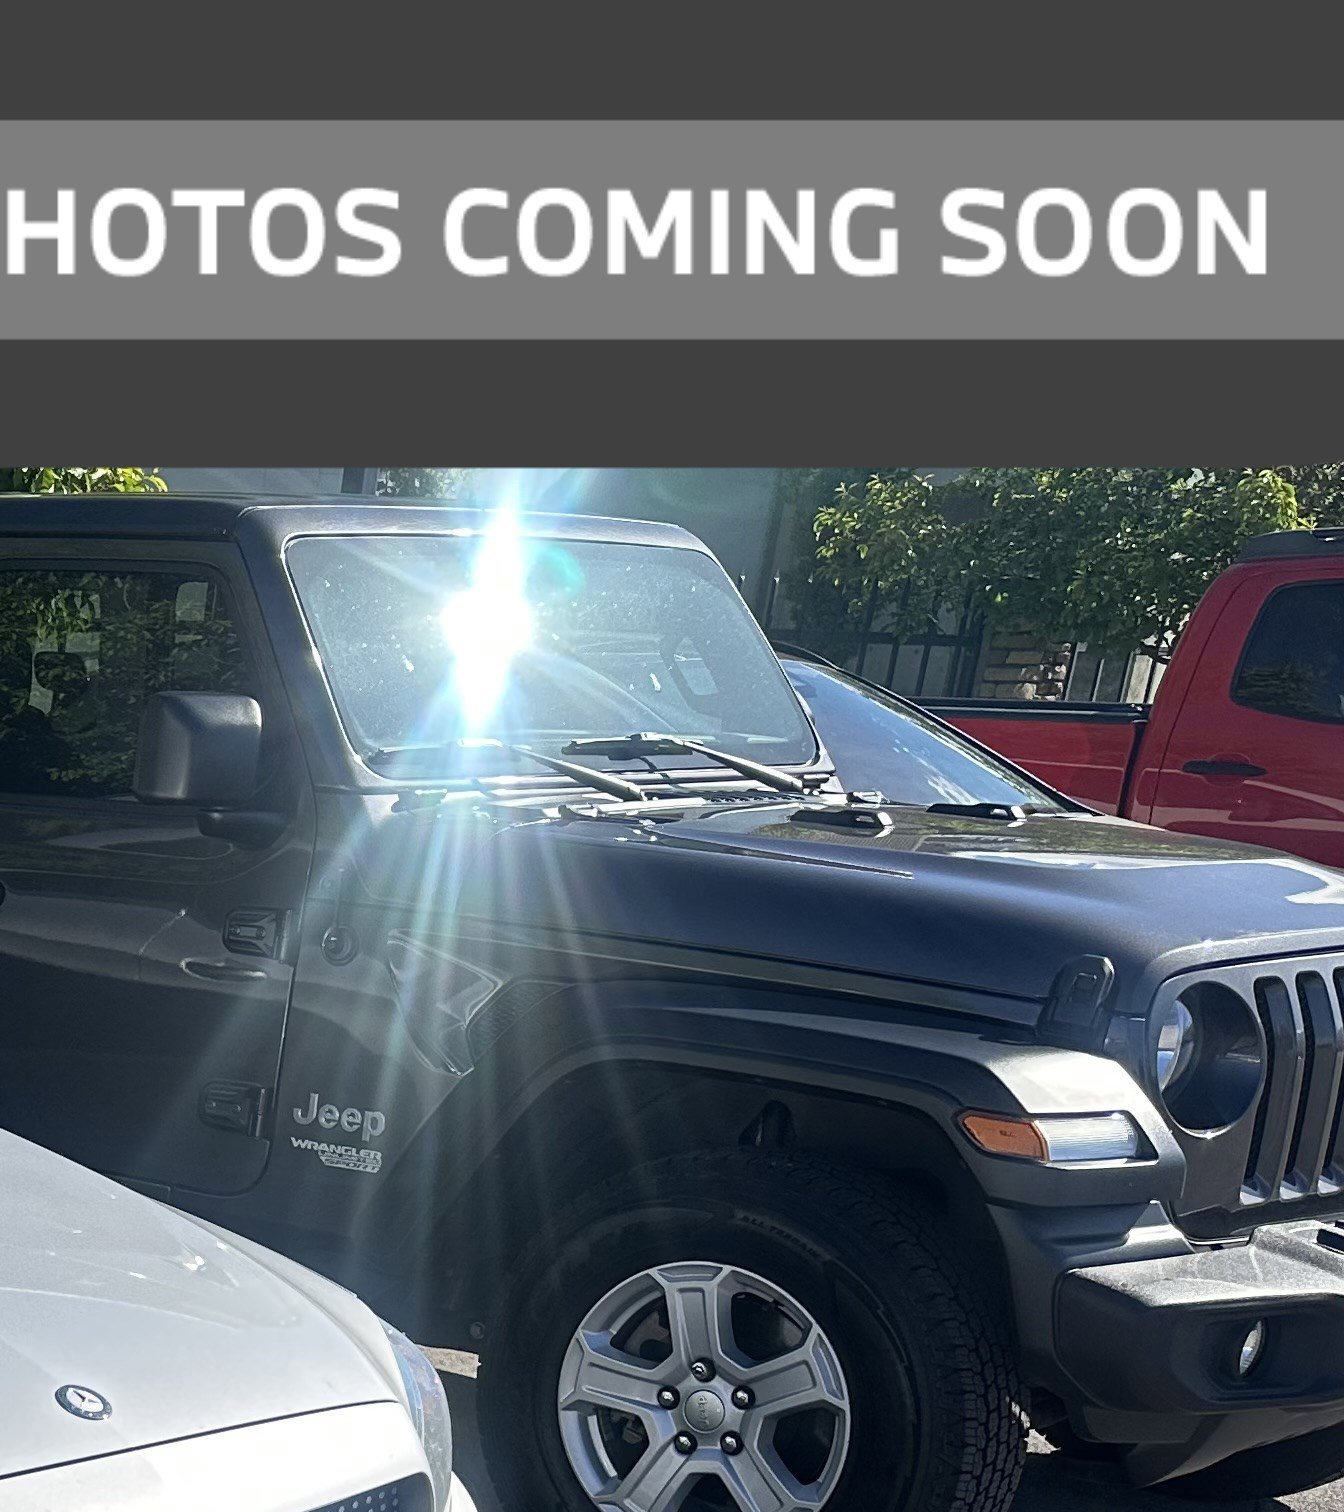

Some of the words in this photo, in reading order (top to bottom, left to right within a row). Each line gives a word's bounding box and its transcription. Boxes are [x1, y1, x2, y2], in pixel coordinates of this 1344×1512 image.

[292, 1093, 386, 1142] Jeep
[290, 1136, 383, 1160] WRANGLER
[323, 1157, 381, 1173] SPORT
